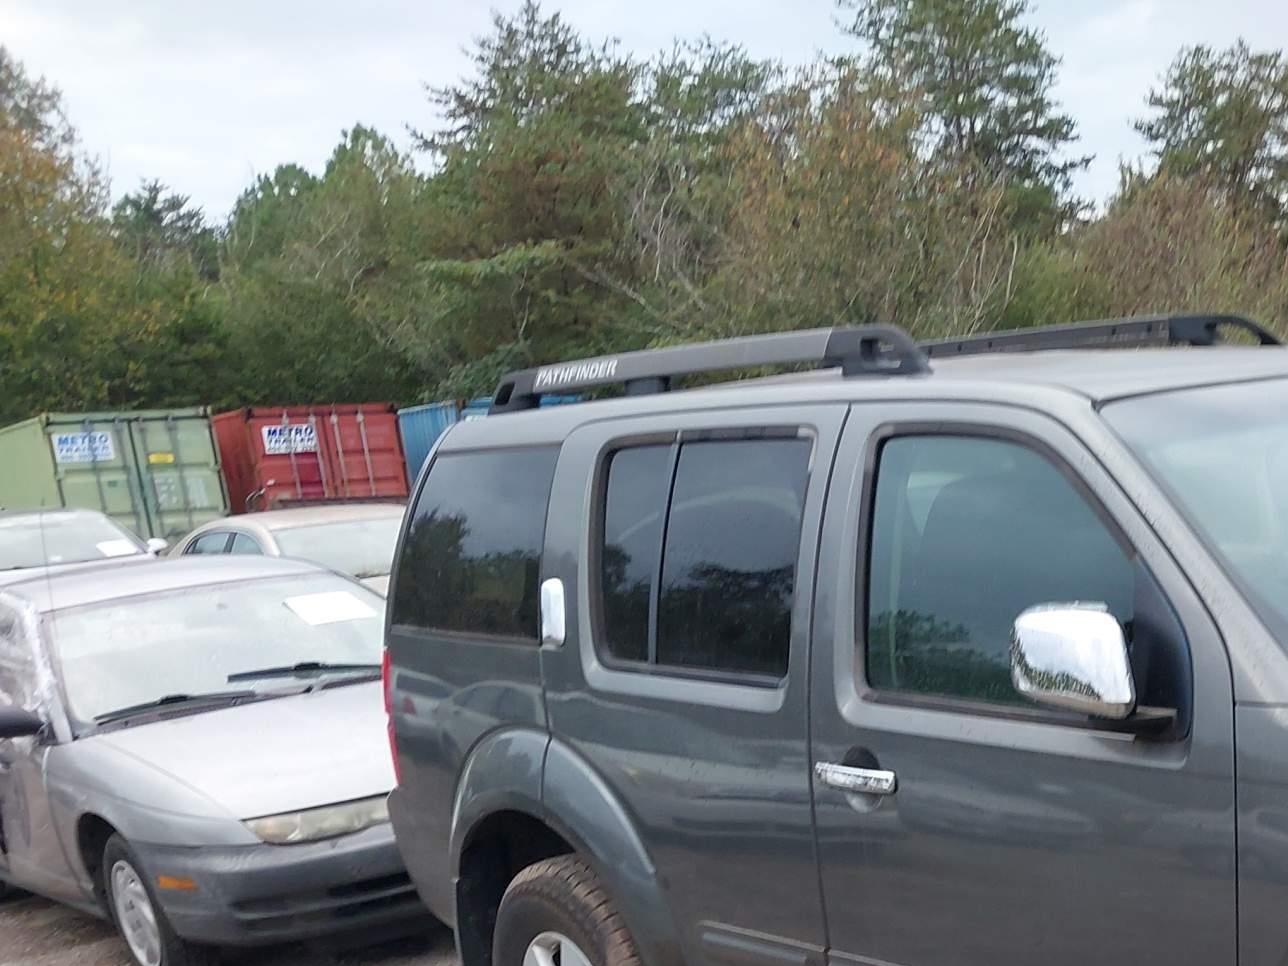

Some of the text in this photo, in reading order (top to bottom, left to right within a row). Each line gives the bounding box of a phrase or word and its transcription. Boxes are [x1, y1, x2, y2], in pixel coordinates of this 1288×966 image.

[535, 359, 618, 387] PATHFINDER
[267, 426, 313, 437] METRO
[57, 434, 109, 446] METRO
